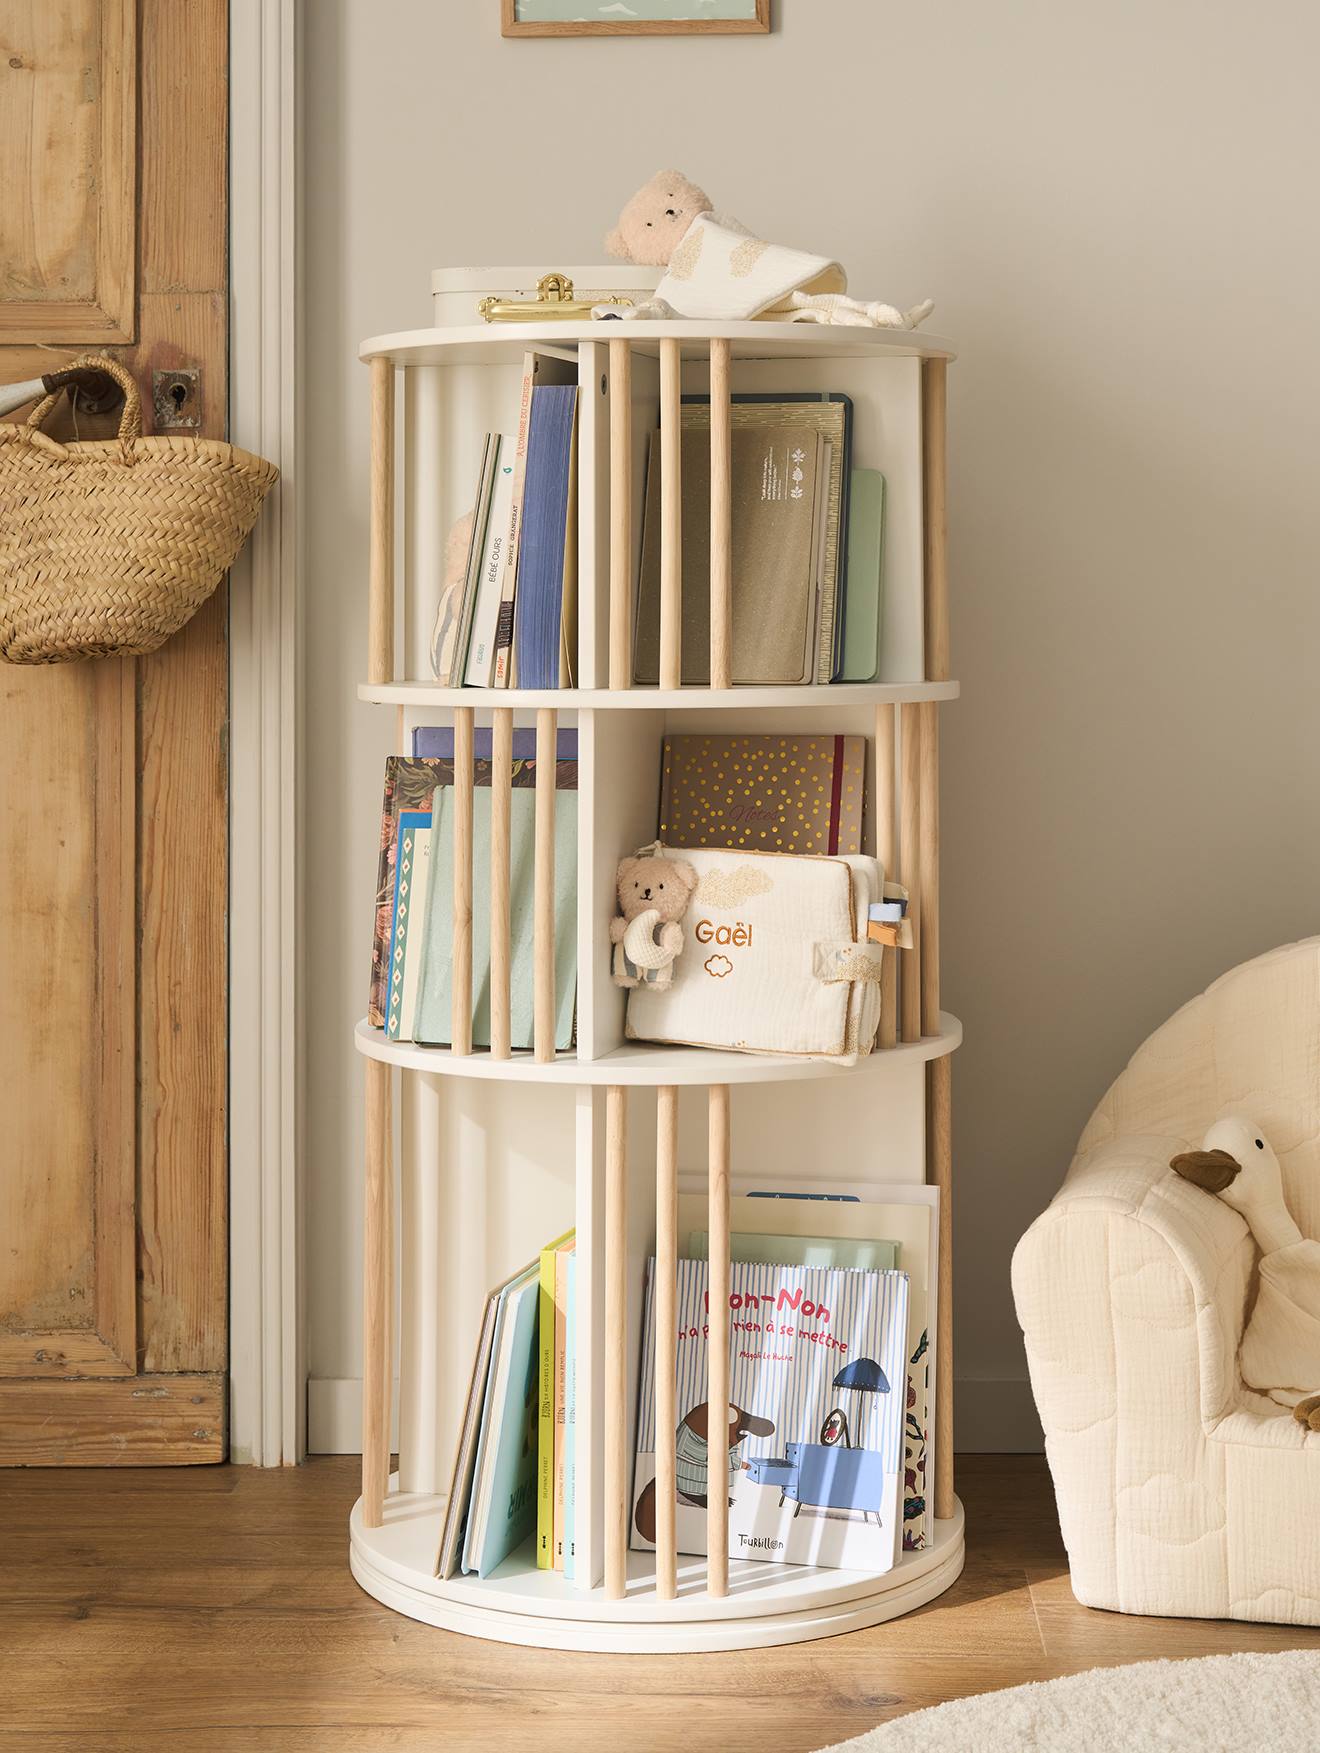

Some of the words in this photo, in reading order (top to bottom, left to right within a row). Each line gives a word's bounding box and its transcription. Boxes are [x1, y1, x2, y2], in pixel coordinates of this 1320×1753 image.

[491, 537, 503, 561] OURS
[488, 562, 499, 583] BÉBÉ
[695, 919, 753, 947] Gaël
[704, 1288, 831, 1324] on-Non
[733, 1319, 761, 1333] rien
[766, 1319, 775, 1333] à
[780, 1325, 794, 1337] se
[798, 1329, 849, 1354] mettre
